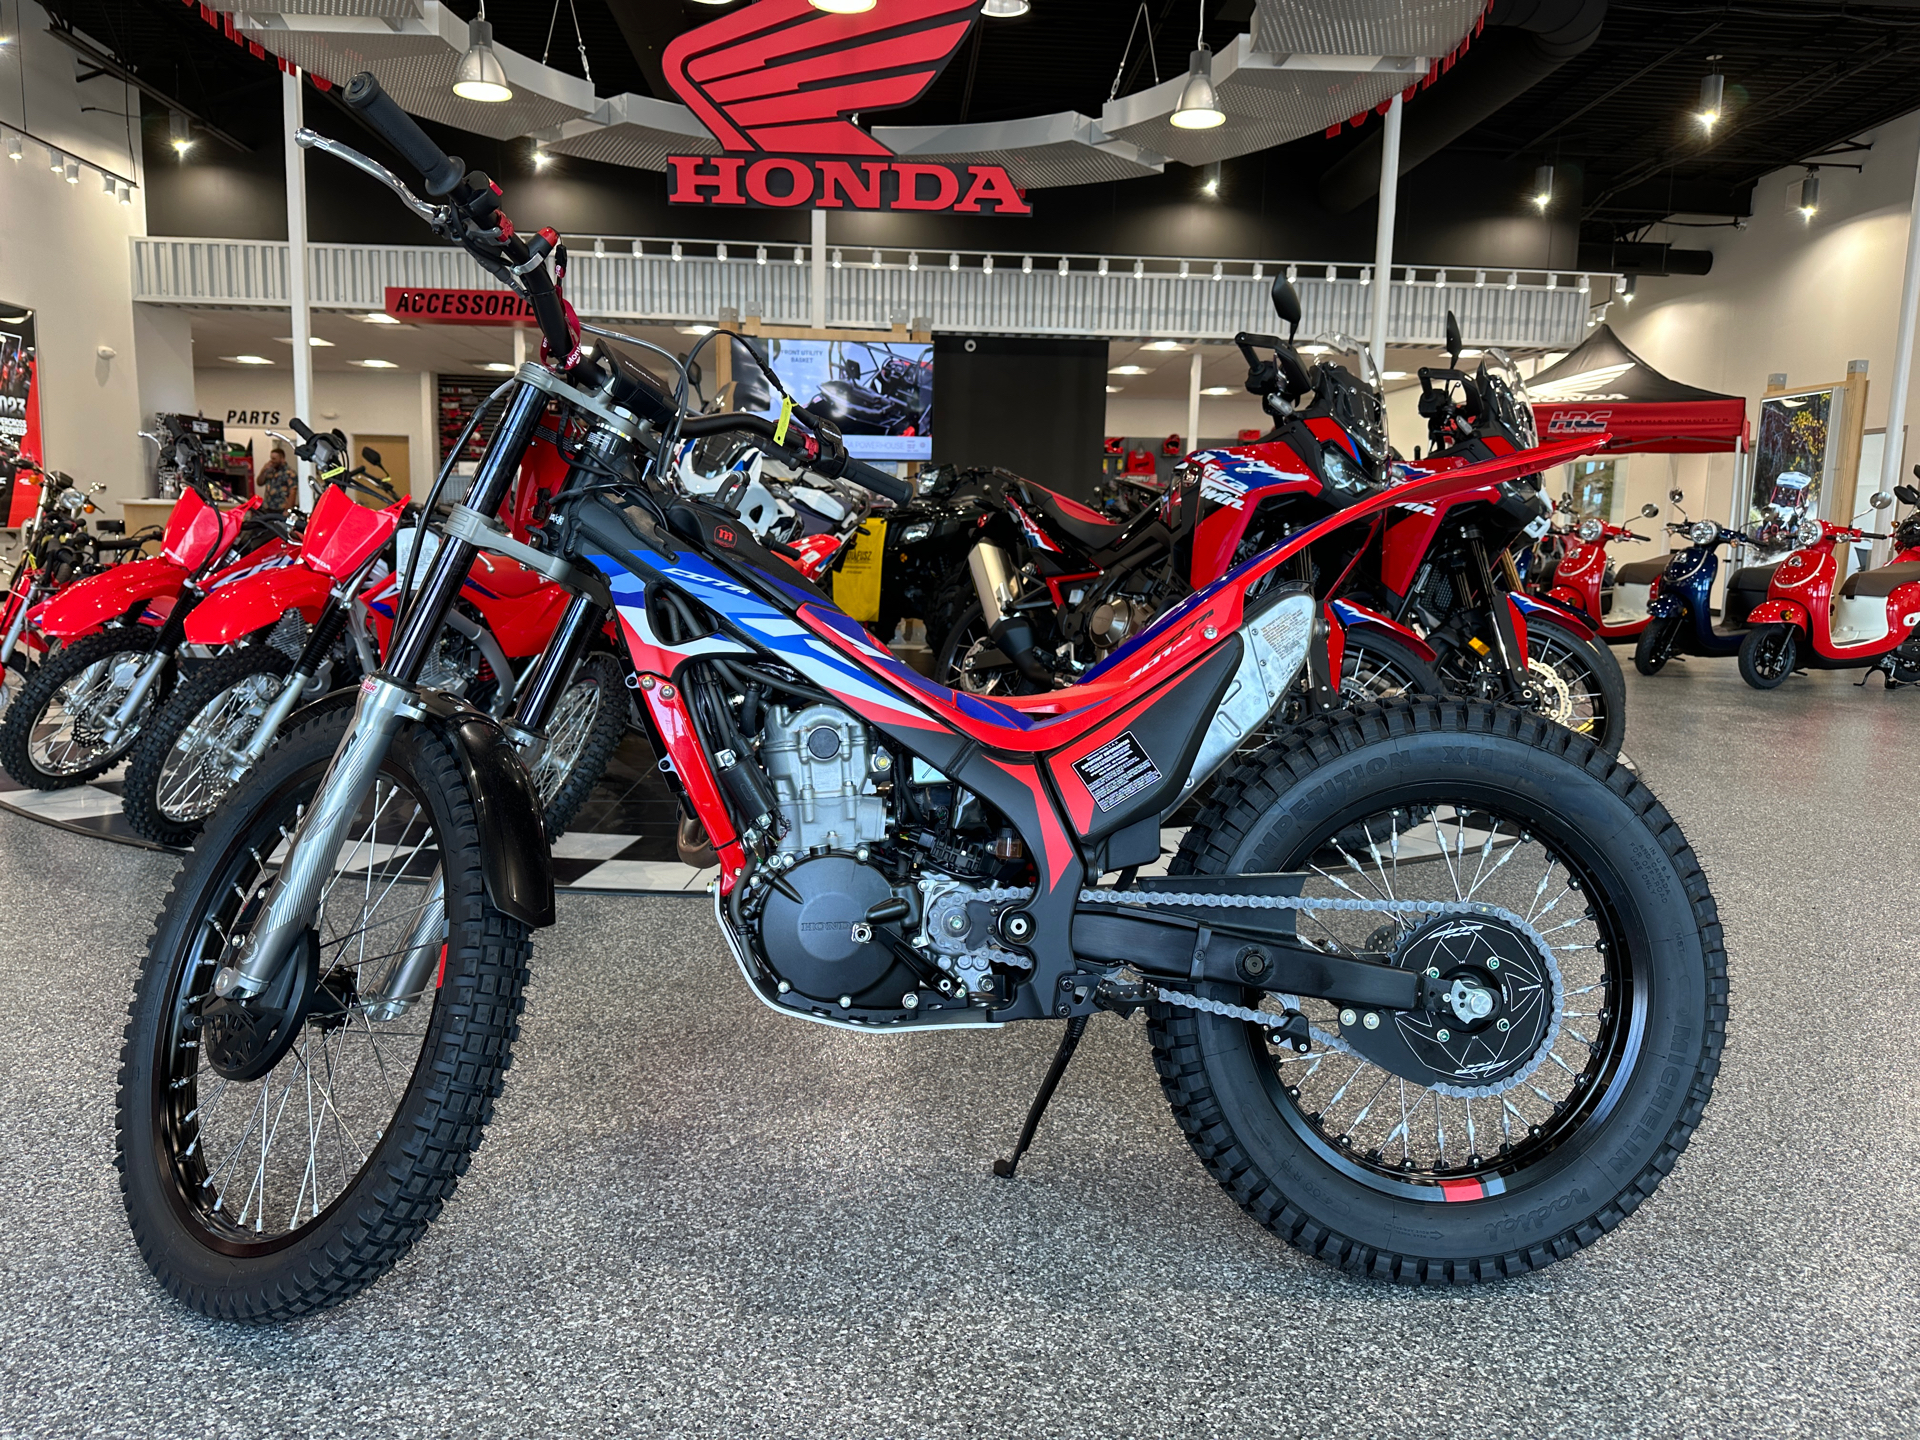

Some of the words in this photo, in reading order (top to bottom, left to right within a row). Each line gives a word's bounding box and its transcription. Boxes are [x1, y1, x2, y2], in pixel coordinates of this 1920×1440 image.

[667, 155, 1031, 214] HONDA
[226, 410, 280, 425] PARTS
[1548, 410, 1613, 430] HRC
[307, 553, 331, 570] HONDA
[661, 567, 751, 596] COTA
[1242, 749, 1412, 874] OMPETITION
[1441, 745, 1494, 767] X11
[1638, 844, 1651, 860] AND
[1651, 862, 1671, 896] CANADA
[1648, 846, 1657, 856] IN
[1629, 842, 1642, 858] FOR
[1641, 859, 1668, 904] OFF-ROAD
[1629, 856, 1643, 872] USE
[1641, 873, 1657, 895] ONLY
[1607, 1024, 1692, 1175] MICHELIN
